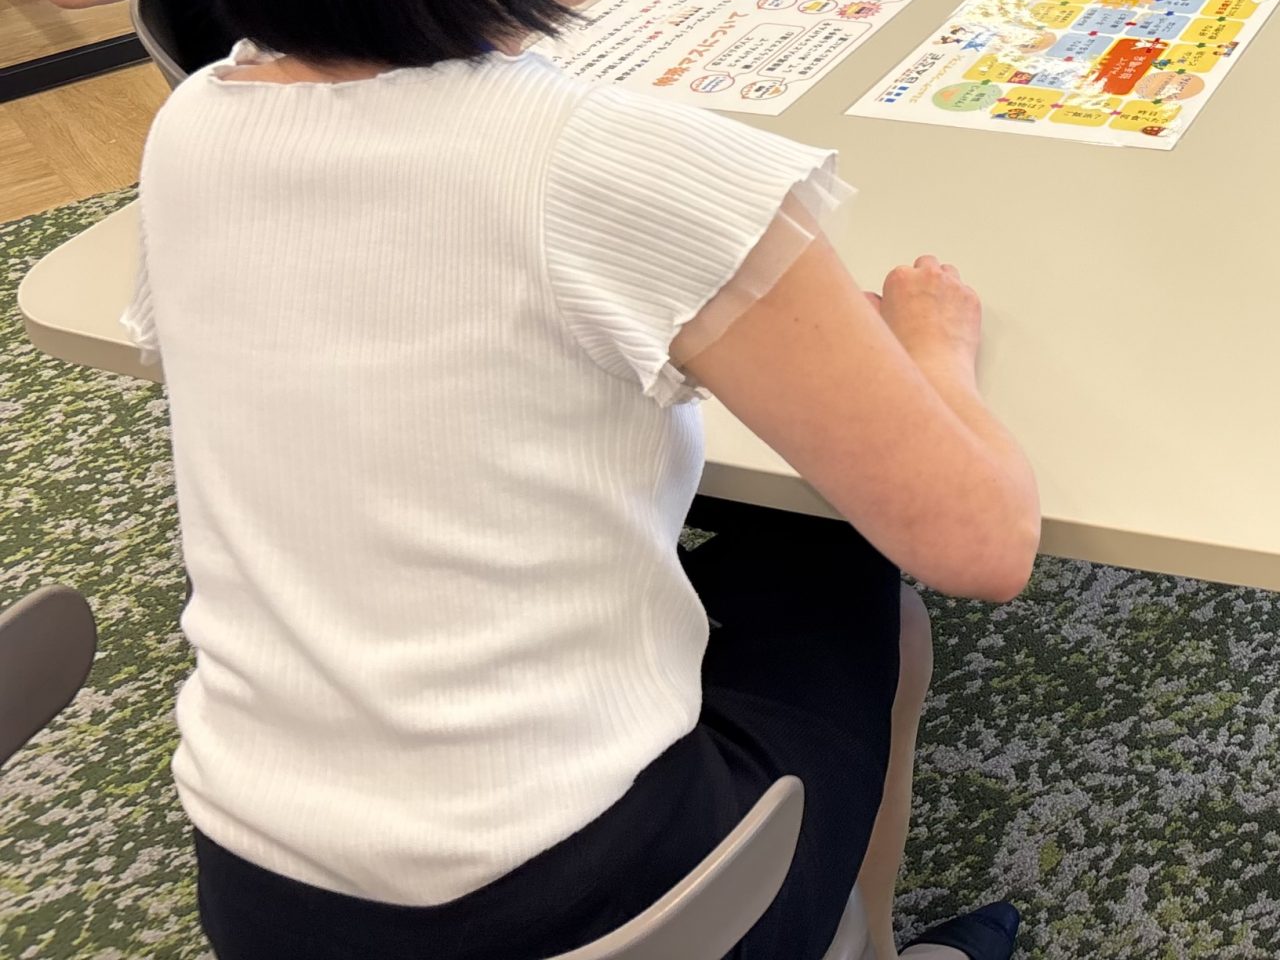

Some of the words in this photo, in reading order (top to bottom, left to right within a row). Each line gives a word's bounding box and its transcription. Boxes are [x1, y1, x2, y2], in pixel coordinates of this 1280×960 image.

[652, 11, 749, 87] 特殊マスについて
[905, 53, 945, 83] BASE
